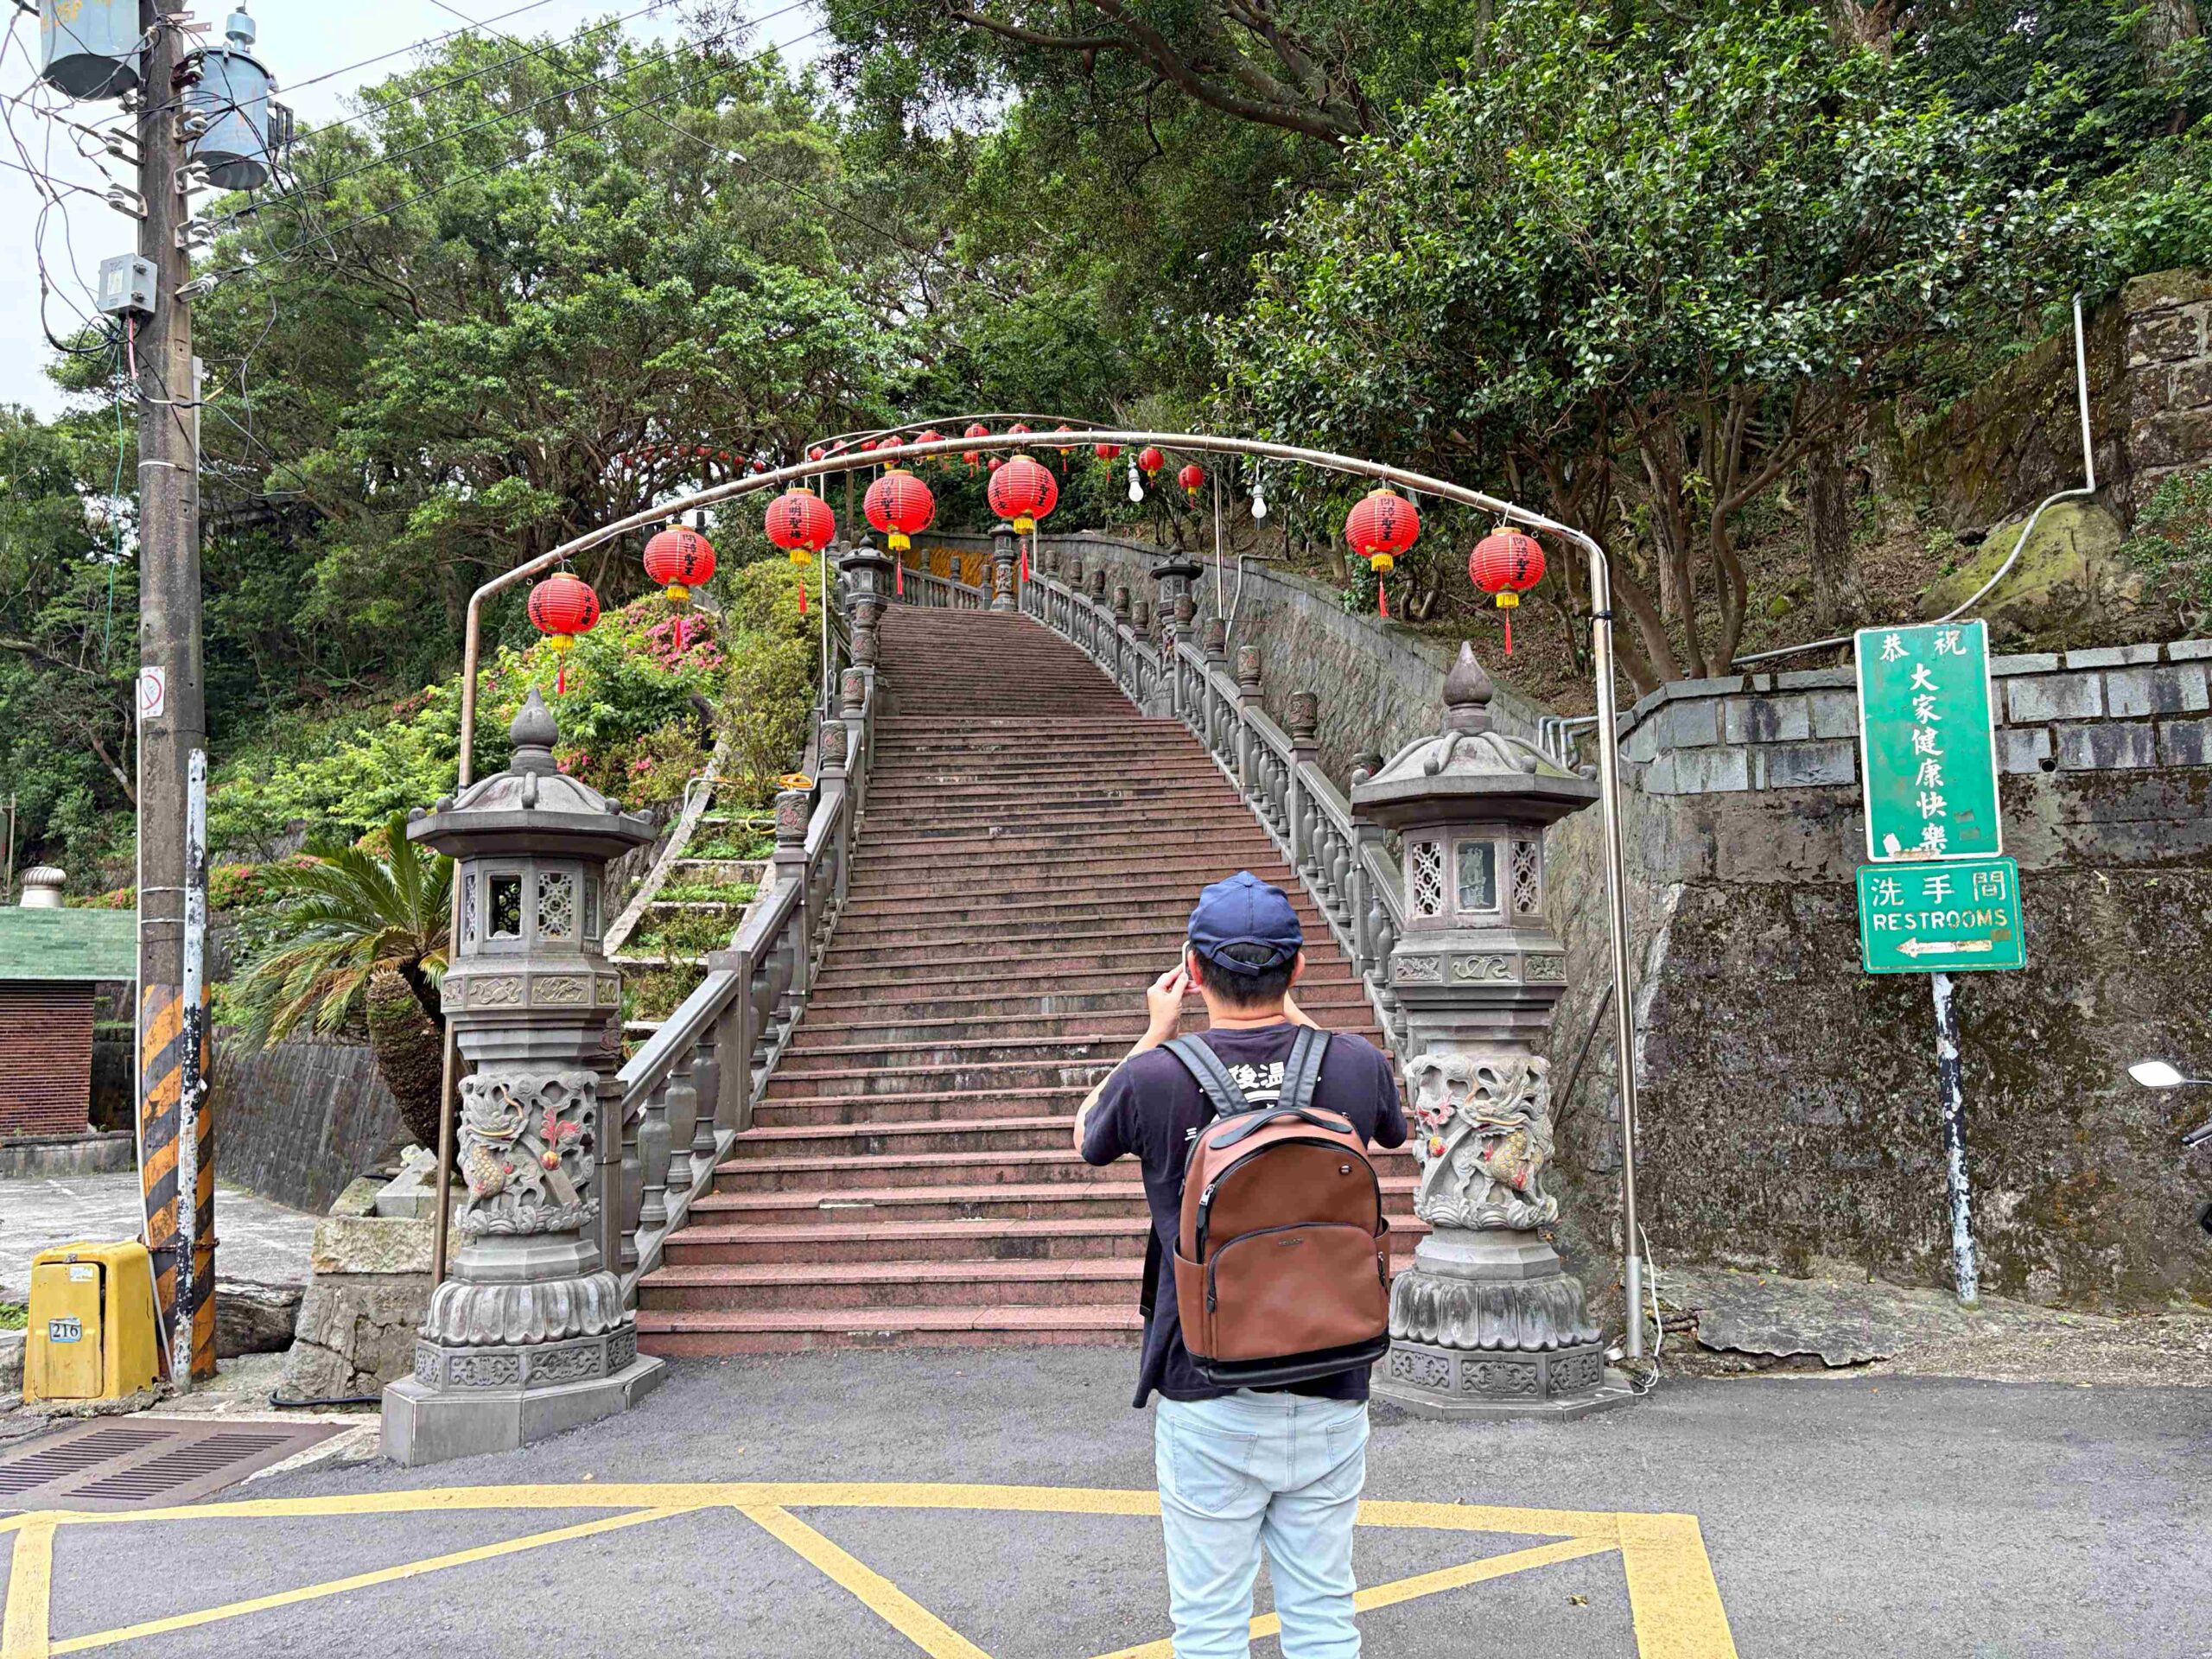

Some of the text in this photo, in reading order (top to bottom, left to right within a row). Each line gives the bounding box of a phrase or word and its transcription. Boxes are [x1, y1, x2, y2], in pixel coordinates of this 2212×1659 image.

[881, 479, 896, 520] 開漳聖王
[1381, 498, 1396, 541] 開漳聖王
[683, 534, 697, 576] 開漳聖王
[1512, 537, 1529, 581] 開漳聖王
[1910, 663, 1948, 856] 大家健康快樂
[1871, 870, 2006, 907] 洗手間
[1872, 908, 2008, 931] RESTROOMS
[53, 1325, 79, 1338] 216
